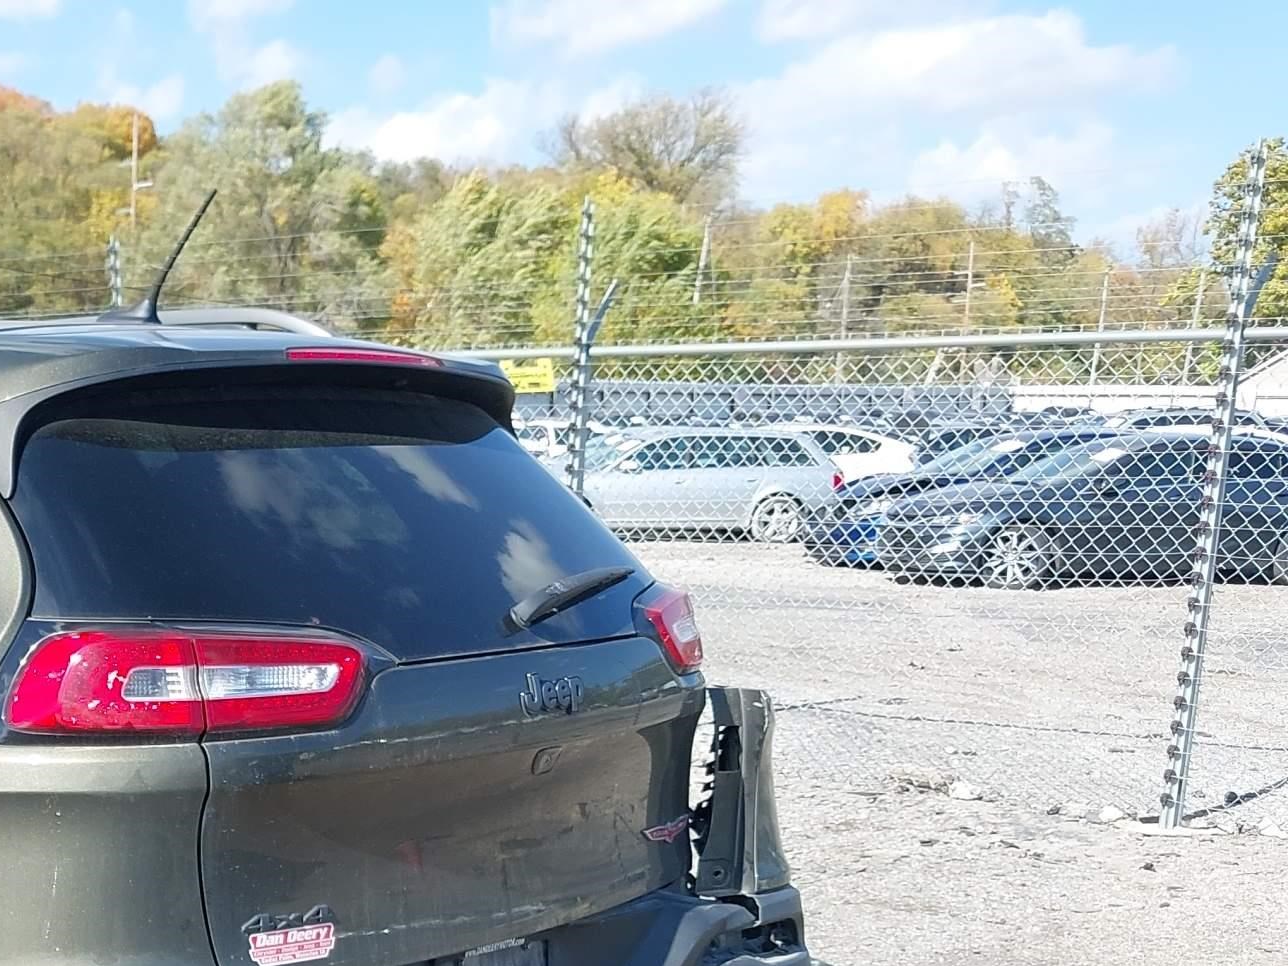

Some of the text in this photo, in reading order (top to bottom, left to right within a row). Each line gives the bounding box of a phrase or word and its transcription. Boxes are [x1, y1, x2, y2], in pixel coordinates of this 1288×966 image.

[519, 672, 584, 718] Jeep
[255, 926, 328, 948] Dan Deery
